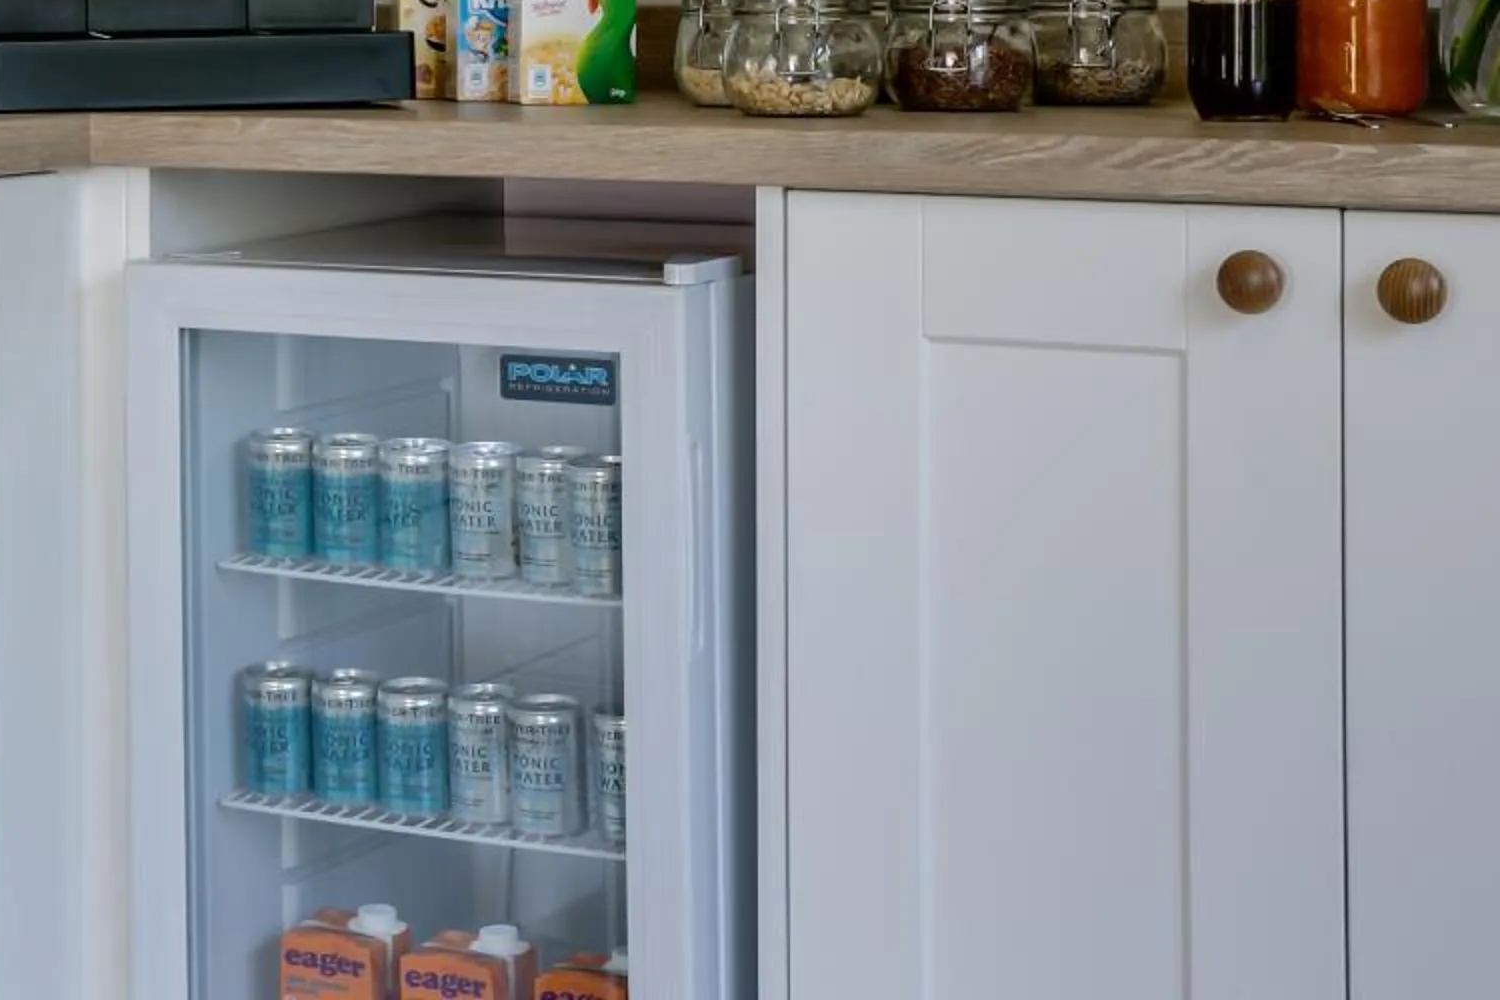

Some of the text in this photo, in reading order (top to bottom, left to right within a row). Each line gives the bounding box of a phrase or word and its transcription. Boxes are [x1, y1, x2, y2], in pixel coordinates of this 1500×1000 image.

[507, 361, 610, 387] POLAR
[285, 950, 365, 977] eager
[404, 970, 487, 999] eager
